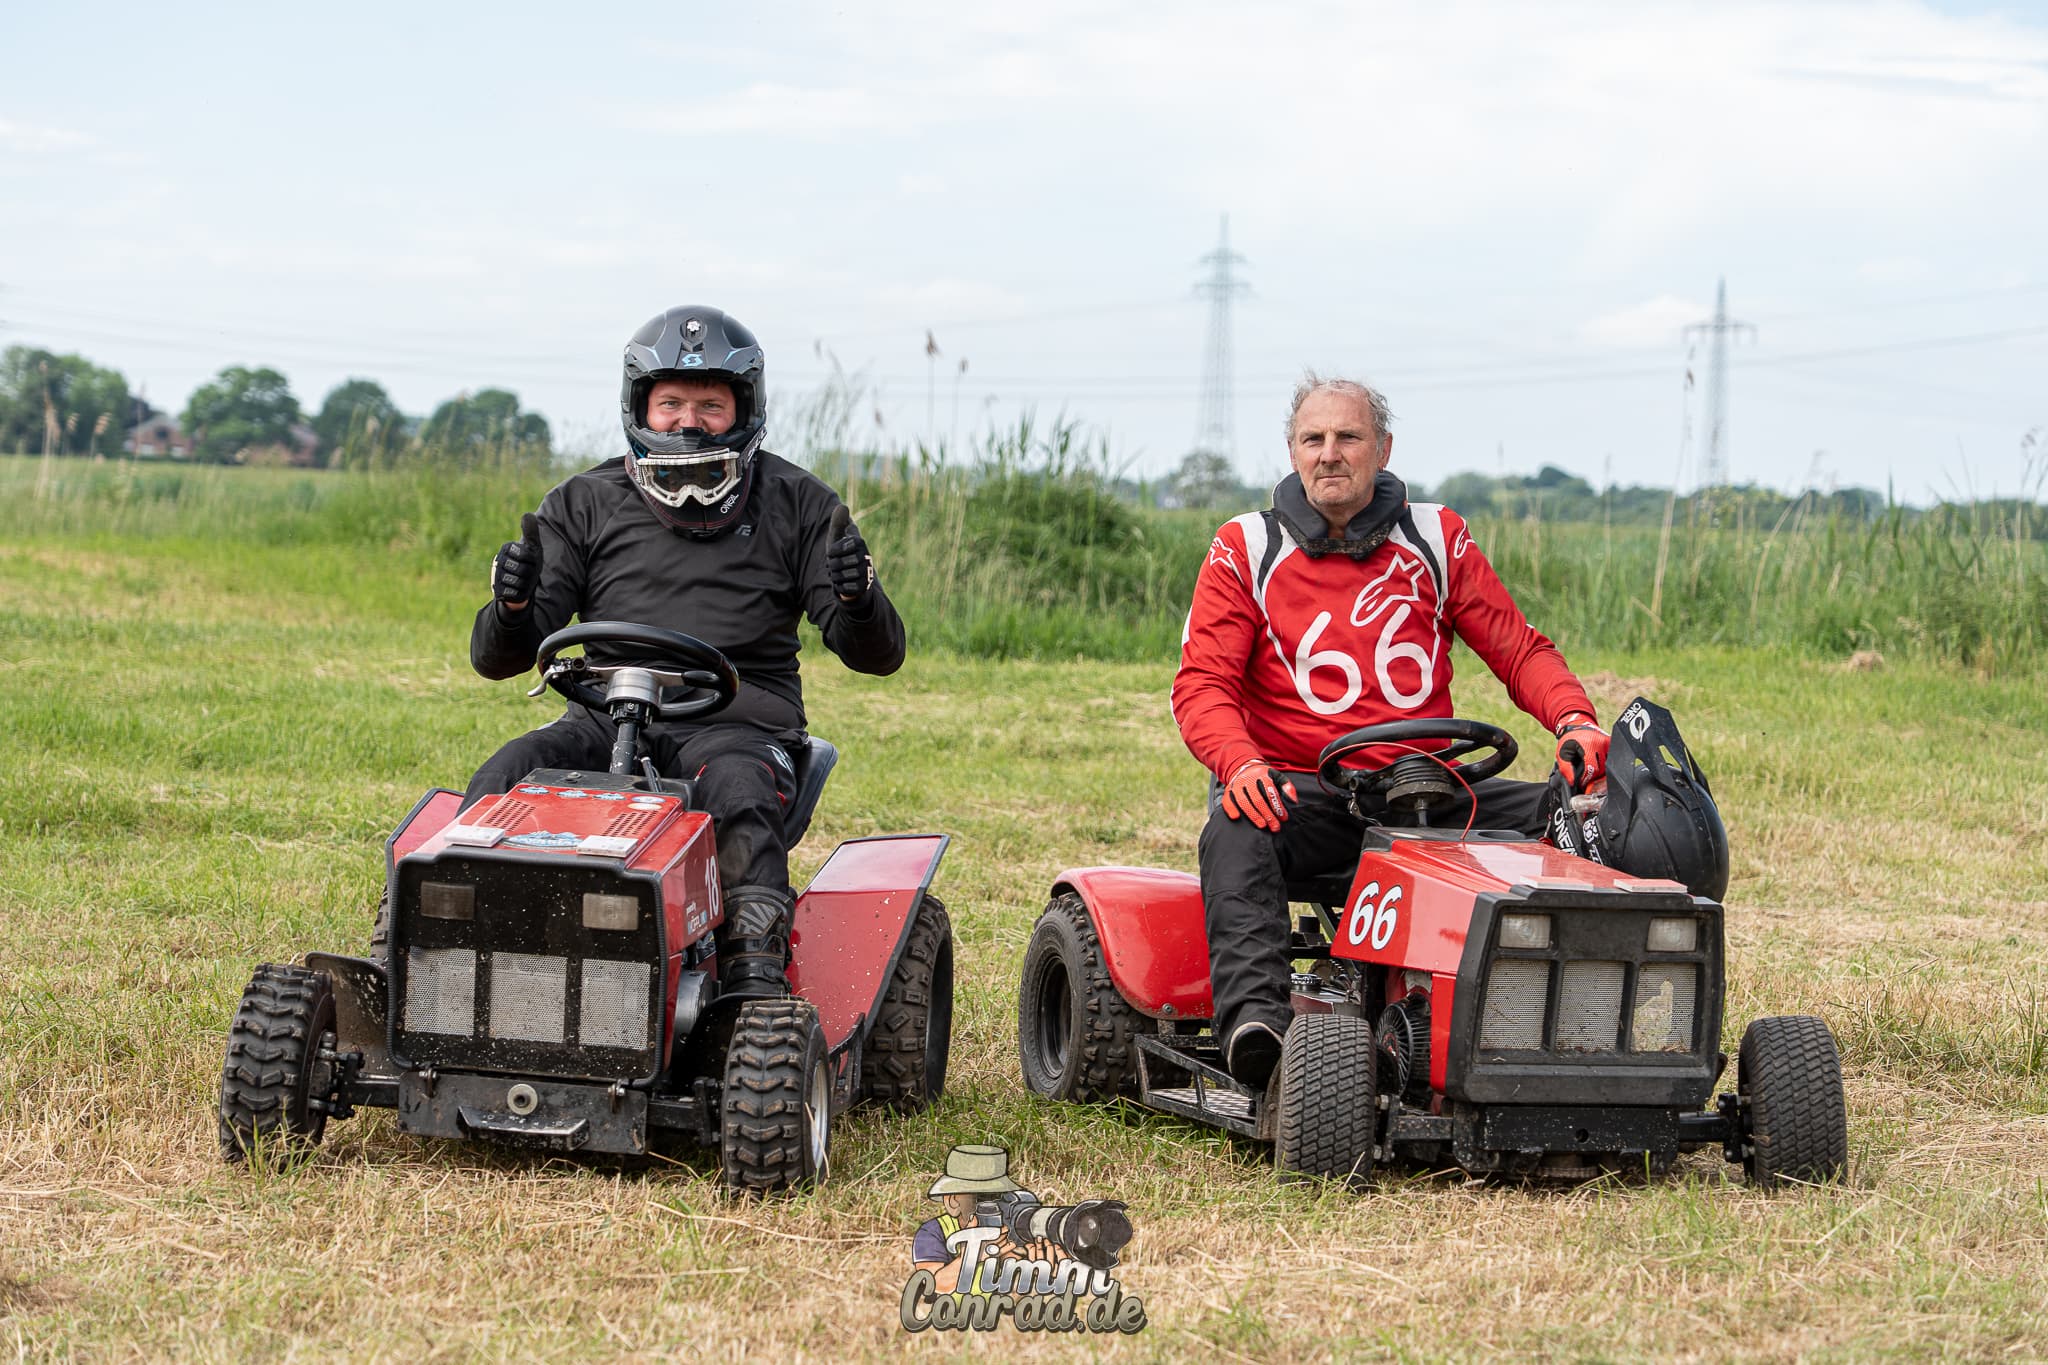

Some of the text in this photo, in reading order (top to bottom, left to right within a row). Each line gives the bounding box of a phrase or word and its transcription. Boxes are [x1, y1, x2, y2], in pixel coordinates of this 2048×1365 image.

[1296, 603, 1434, 714] 66
[705, 855, 719, 920] 18
[1348, 880, 1403, 951] 66
